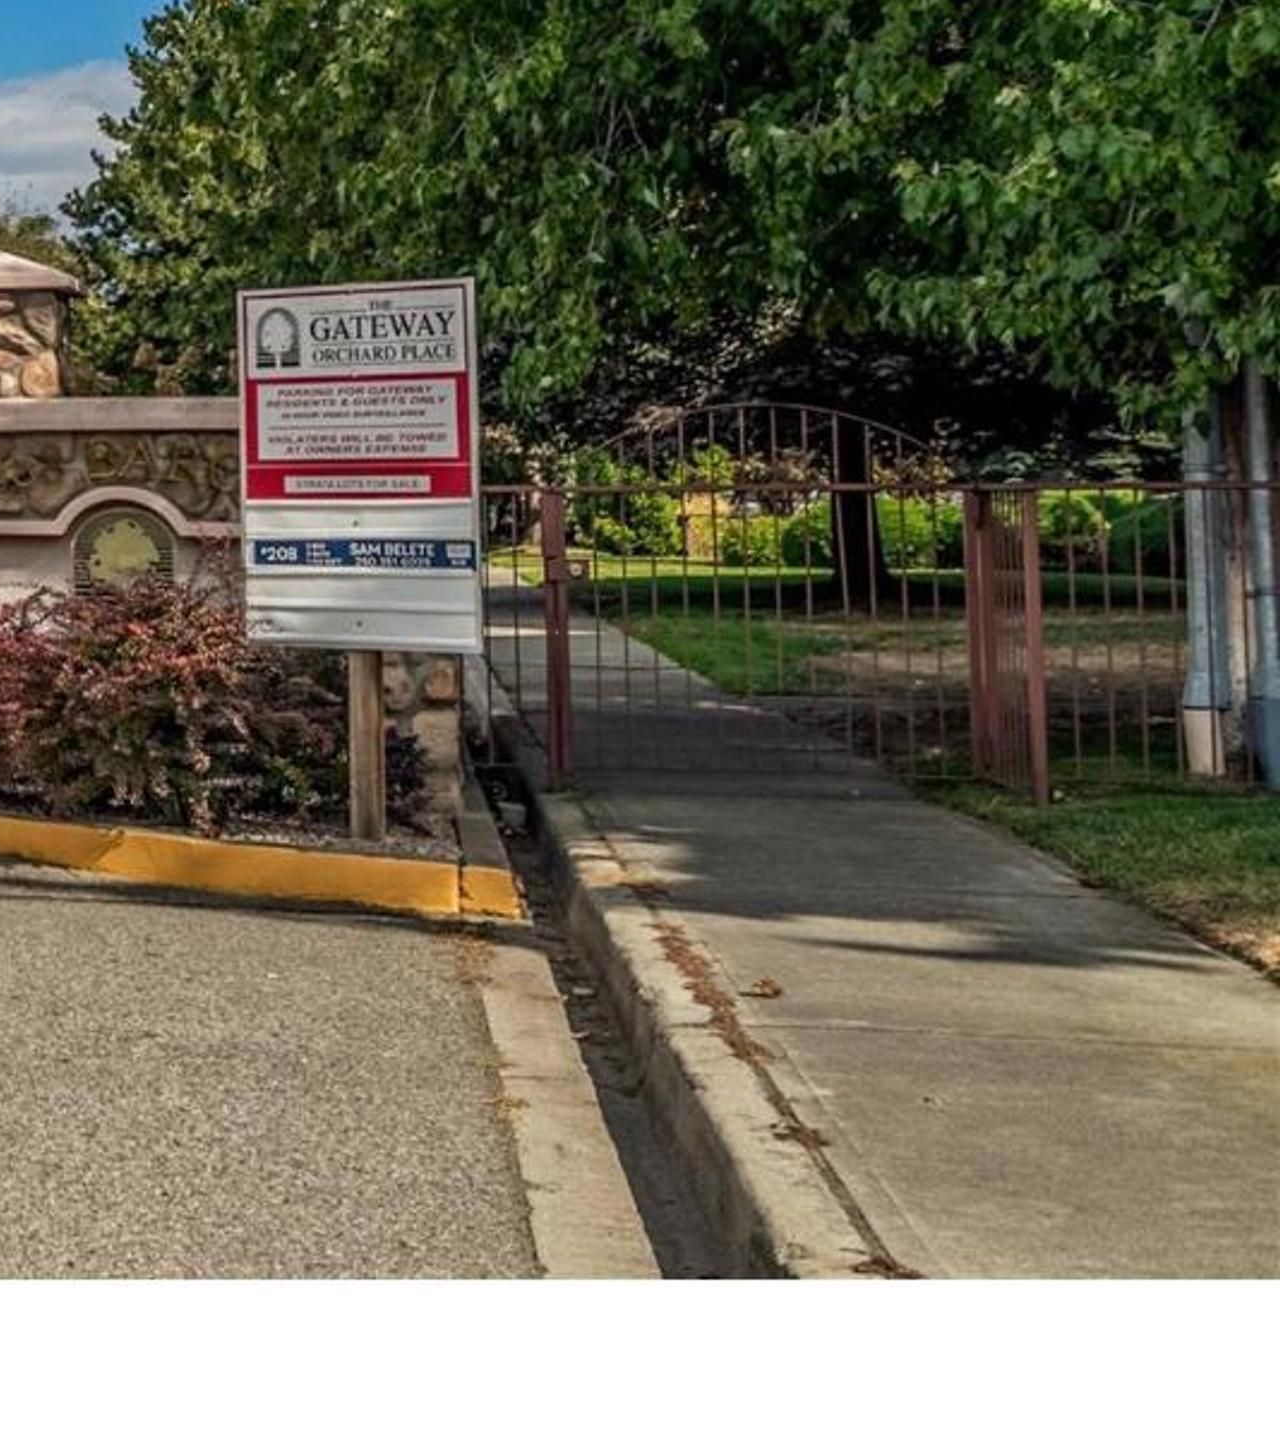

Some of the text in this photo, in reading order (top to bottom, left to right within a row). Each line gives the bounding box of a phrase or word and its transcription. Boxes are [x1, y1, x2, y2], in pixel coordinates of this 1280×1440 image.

[309, 311, 455, 343] GATEWAY
[312, 343, 457, 363] ORCHARD PLACE
[277, 385, 433, 398] PARKING FOR GATEWAY
[266, 398, 337, 409] RESIDENTS
[353, 396, 407, 407] GUESTS
[409, 395, 445, 406] ONLY
[349, 542, 381, 557] SAM
